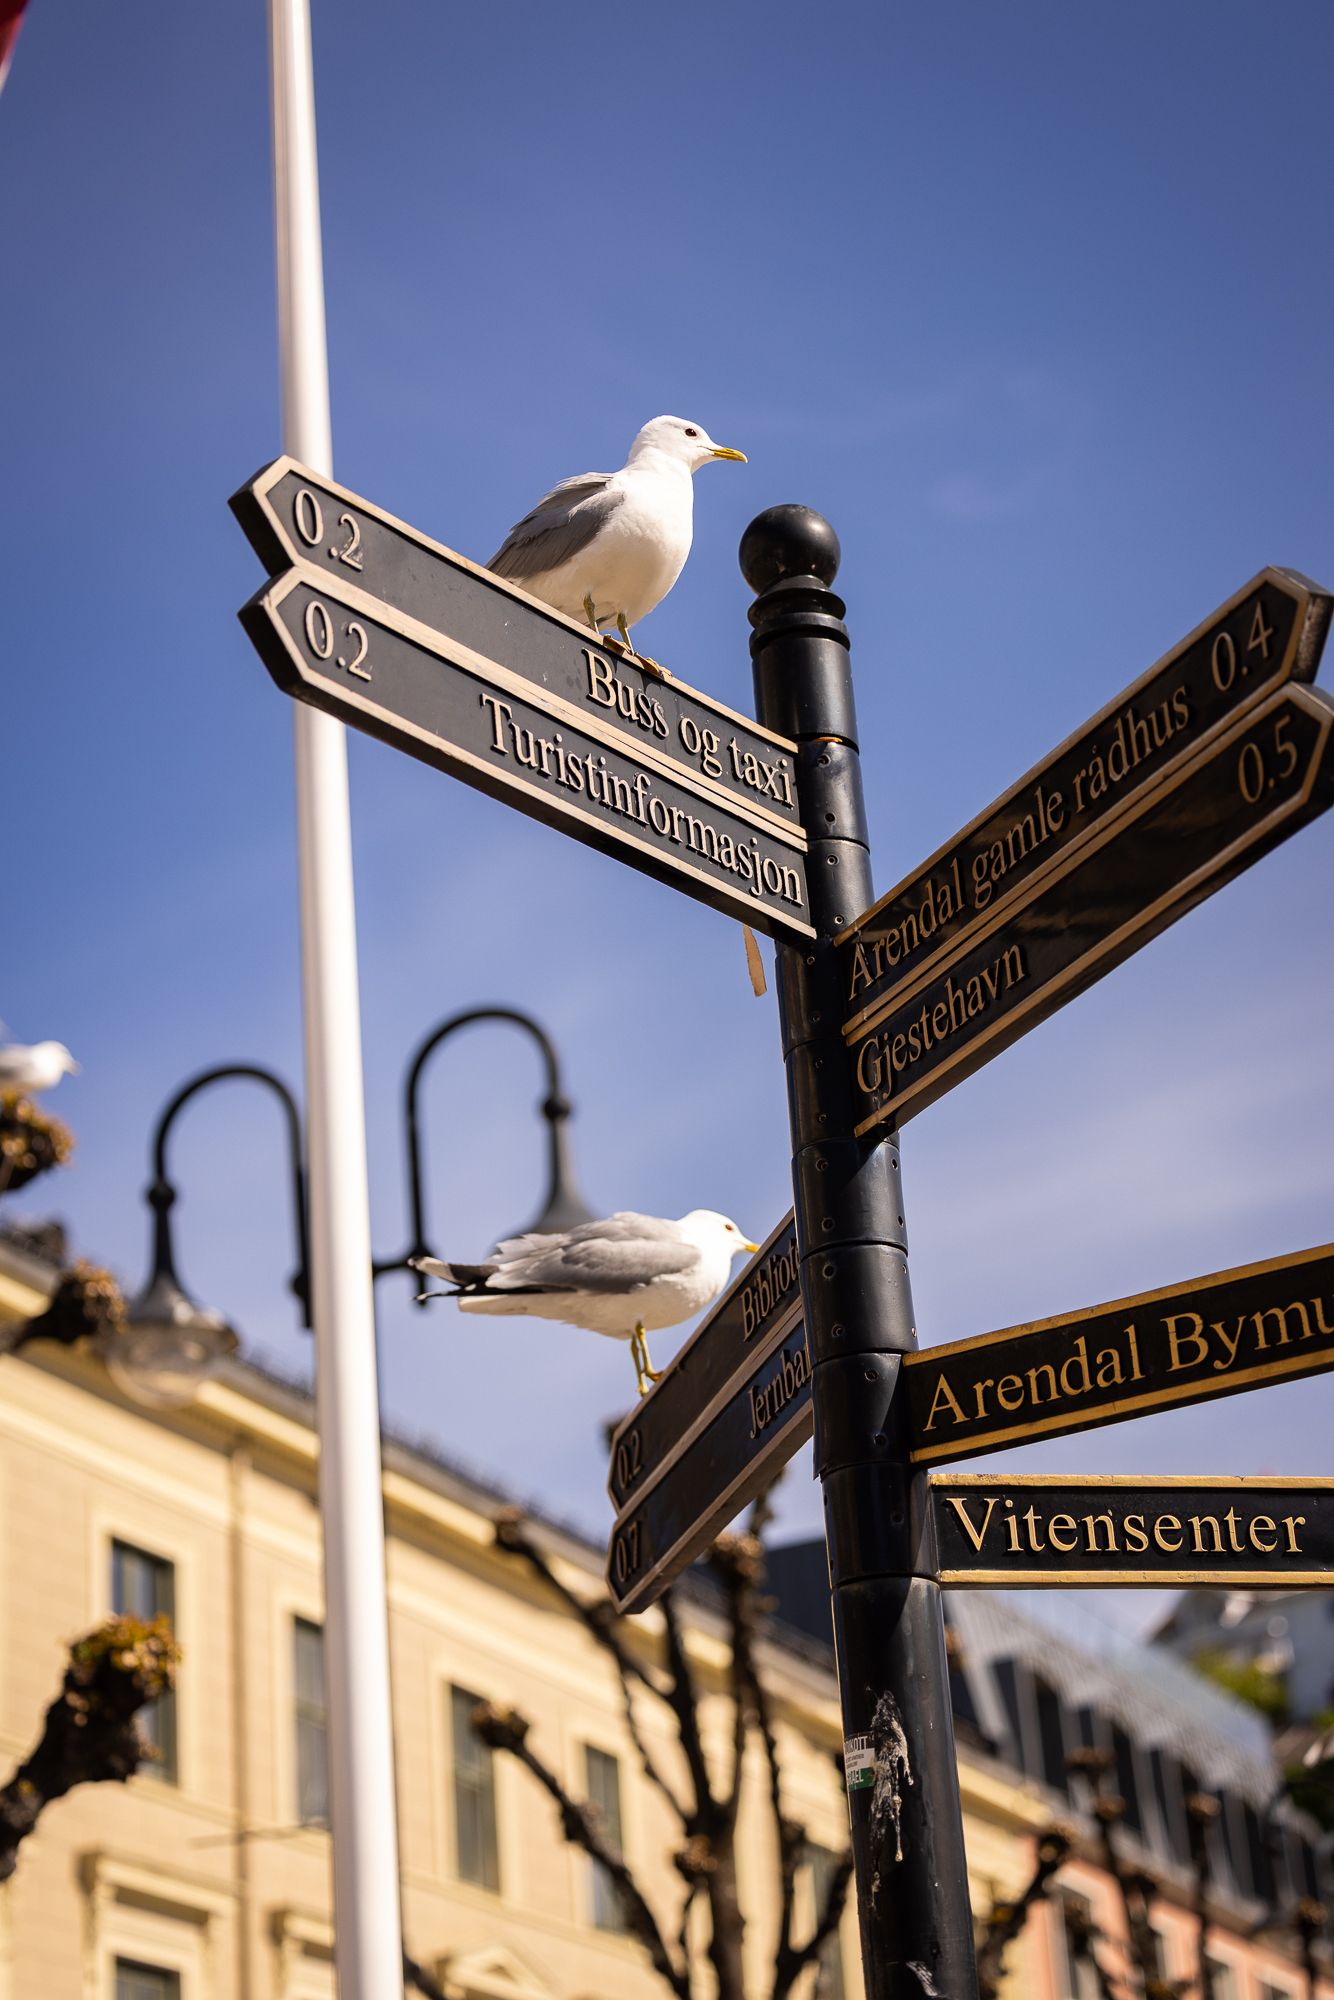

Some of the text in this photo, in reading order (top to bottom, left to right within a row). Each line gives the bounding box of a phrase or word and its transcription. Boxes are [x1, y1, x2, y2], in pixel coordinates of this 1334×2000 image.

[294, 489, 795, 807] 0.2 Buss og taxi
[305, 601, 804, 906] 0.2 Turistinformasjon
[849, 601, 1275, 1000] Arendal gamle rådhus 0.4
[857, 715, 1297, 1098] Gjestehavn 0.5
[618, 1430, 643, 1489] 0.2
[923, 1325, 1145, 1431] Arendal
[946, 1497, 1306, 1553] Vitensenter
